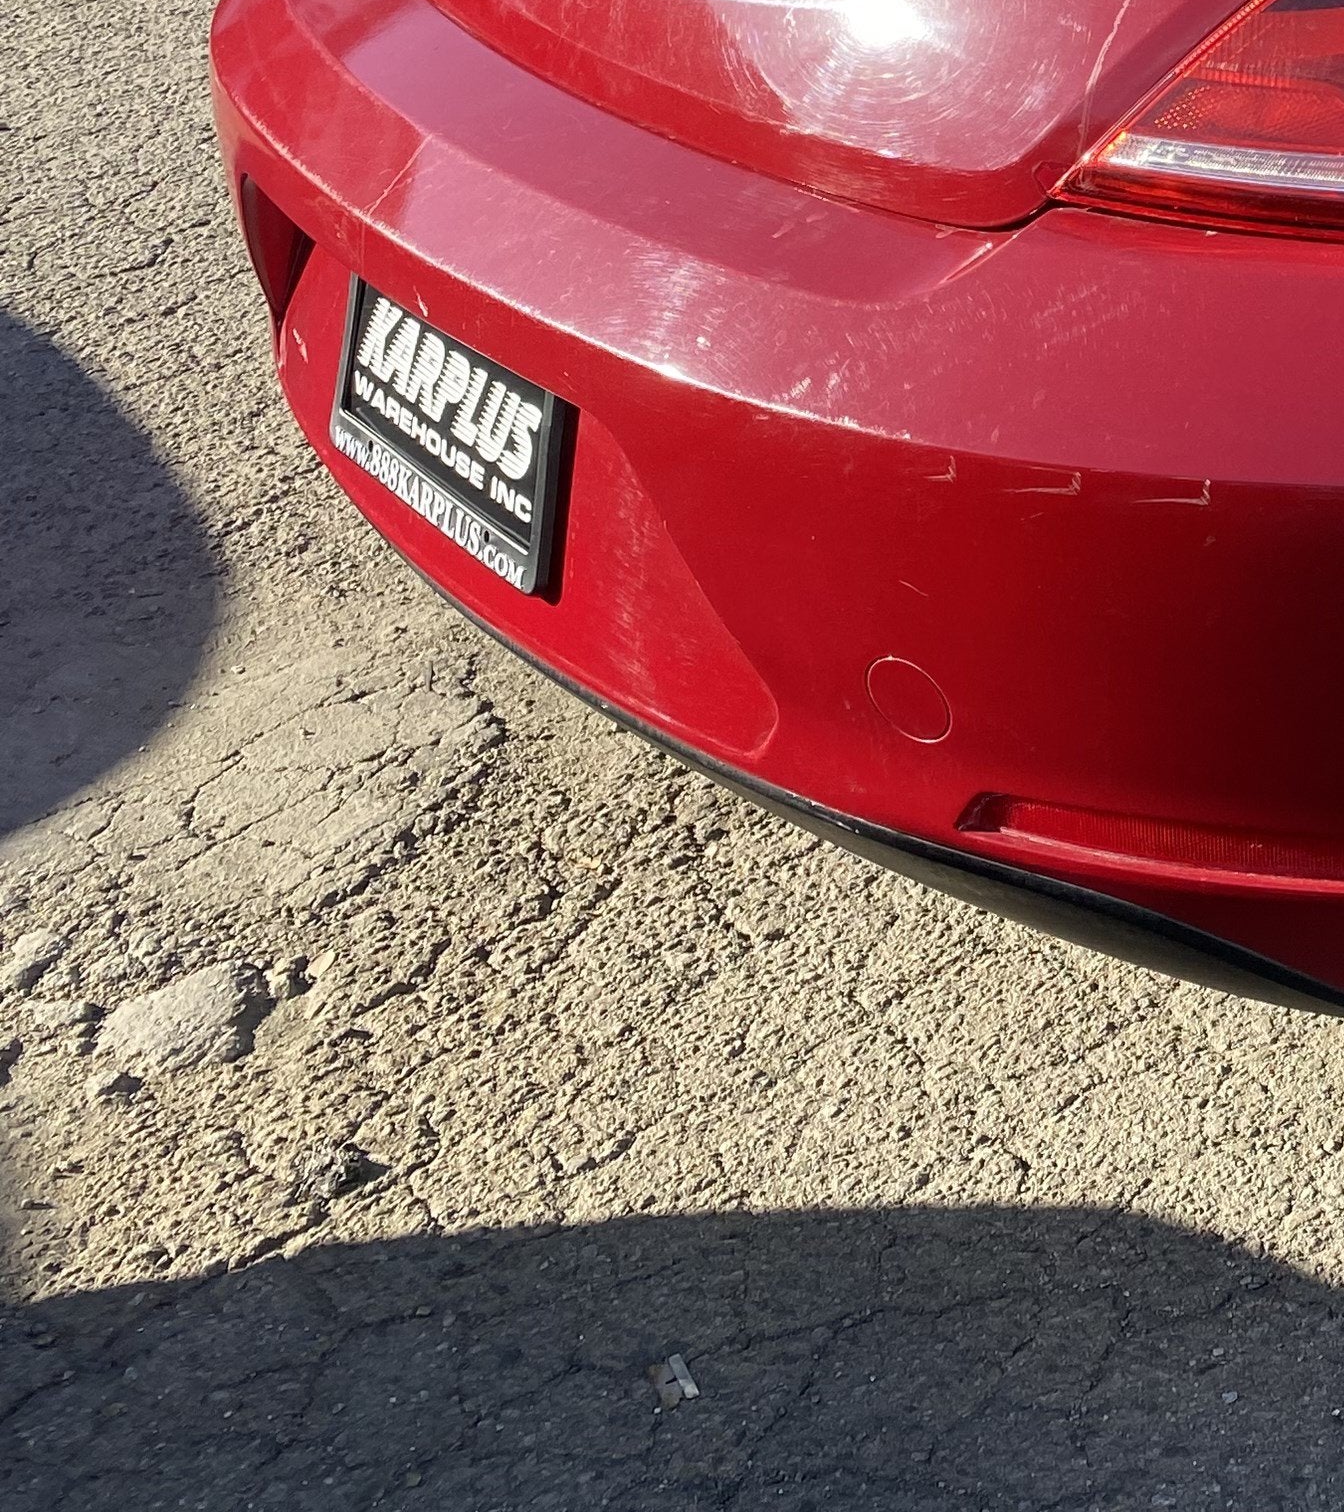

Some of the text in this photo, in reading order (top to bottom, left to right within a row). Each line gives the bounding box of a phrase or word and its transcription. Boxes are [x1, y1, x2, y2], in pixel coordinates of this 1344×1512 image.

[353, 369, 533, 524] WAREHOUSE INC
[356, 296, 543, 481] KARPLUS
